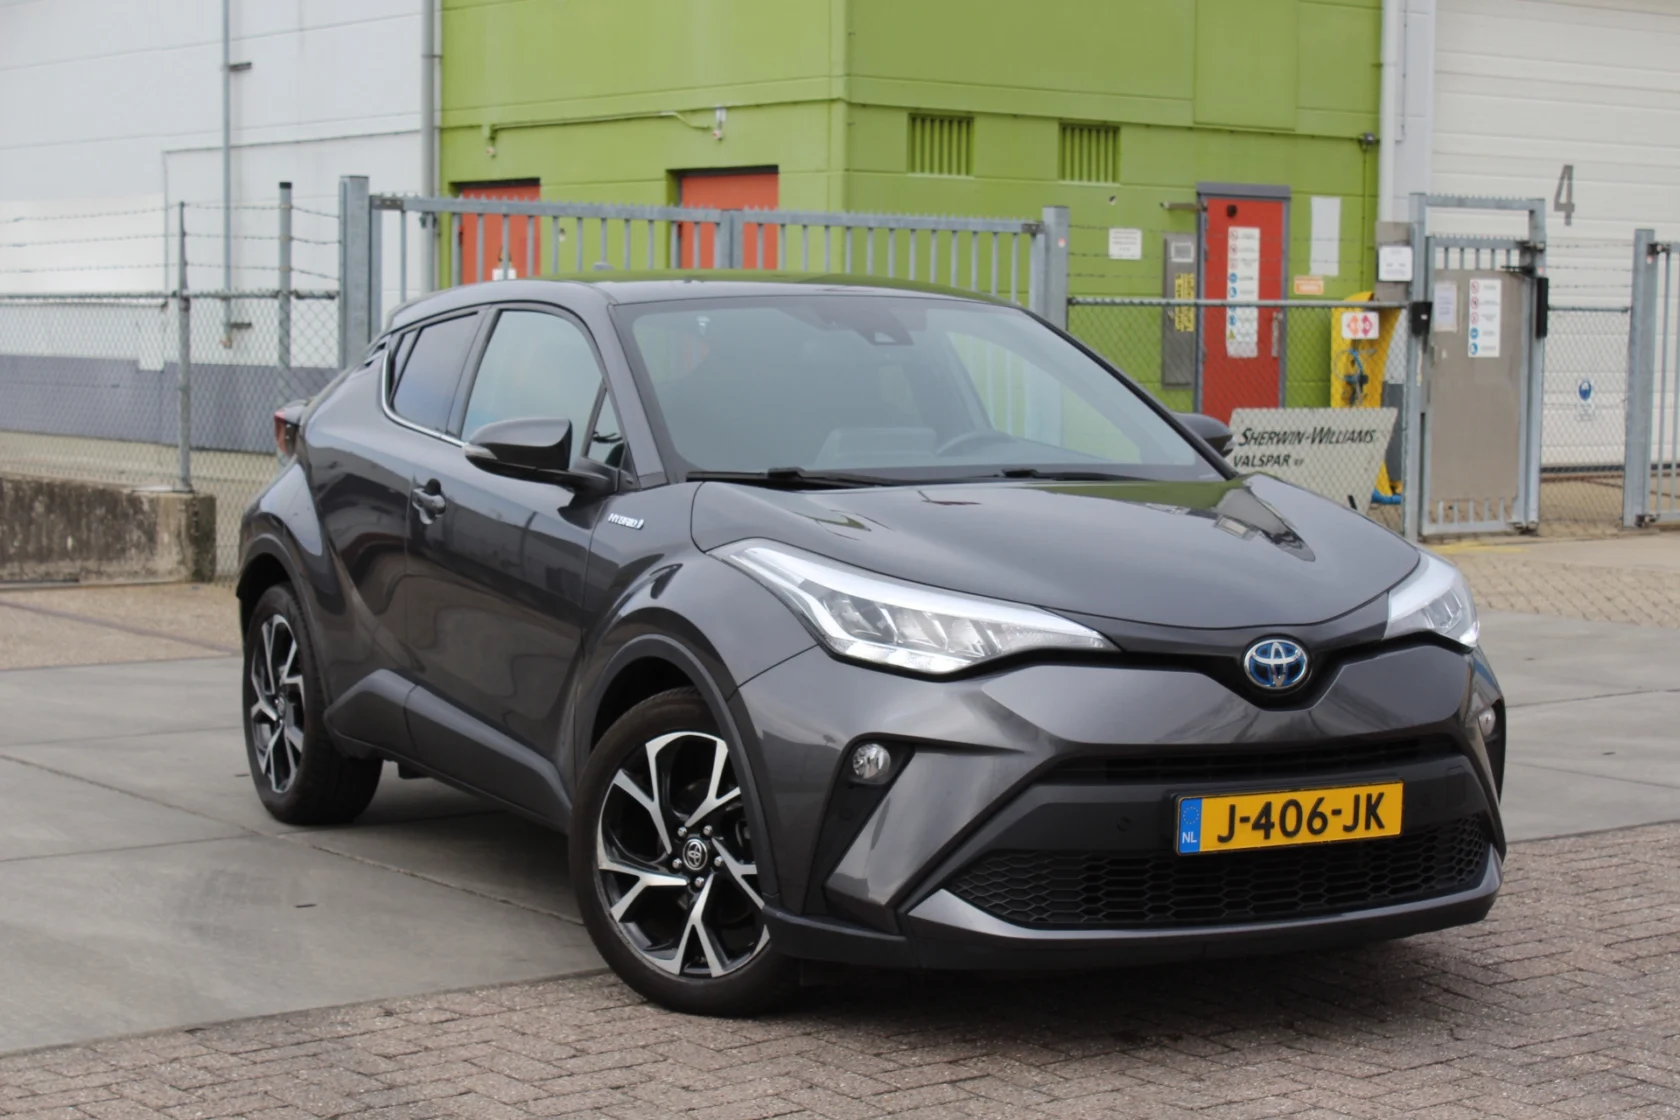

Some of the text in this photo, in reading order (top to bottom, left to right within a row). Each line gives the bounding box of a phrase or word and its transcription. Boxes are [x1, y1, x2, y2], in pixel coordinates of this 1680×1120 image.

[1553, 164, 1575, 226] 4
[1239, 427, 1376, 446] SHERWIN-WILLIAMS
[1233, 453, 1291, 468] VALSPAR
[1217, 792, 1385, 843] J-406-JK
[1181, 831, 1197, 843] NL
